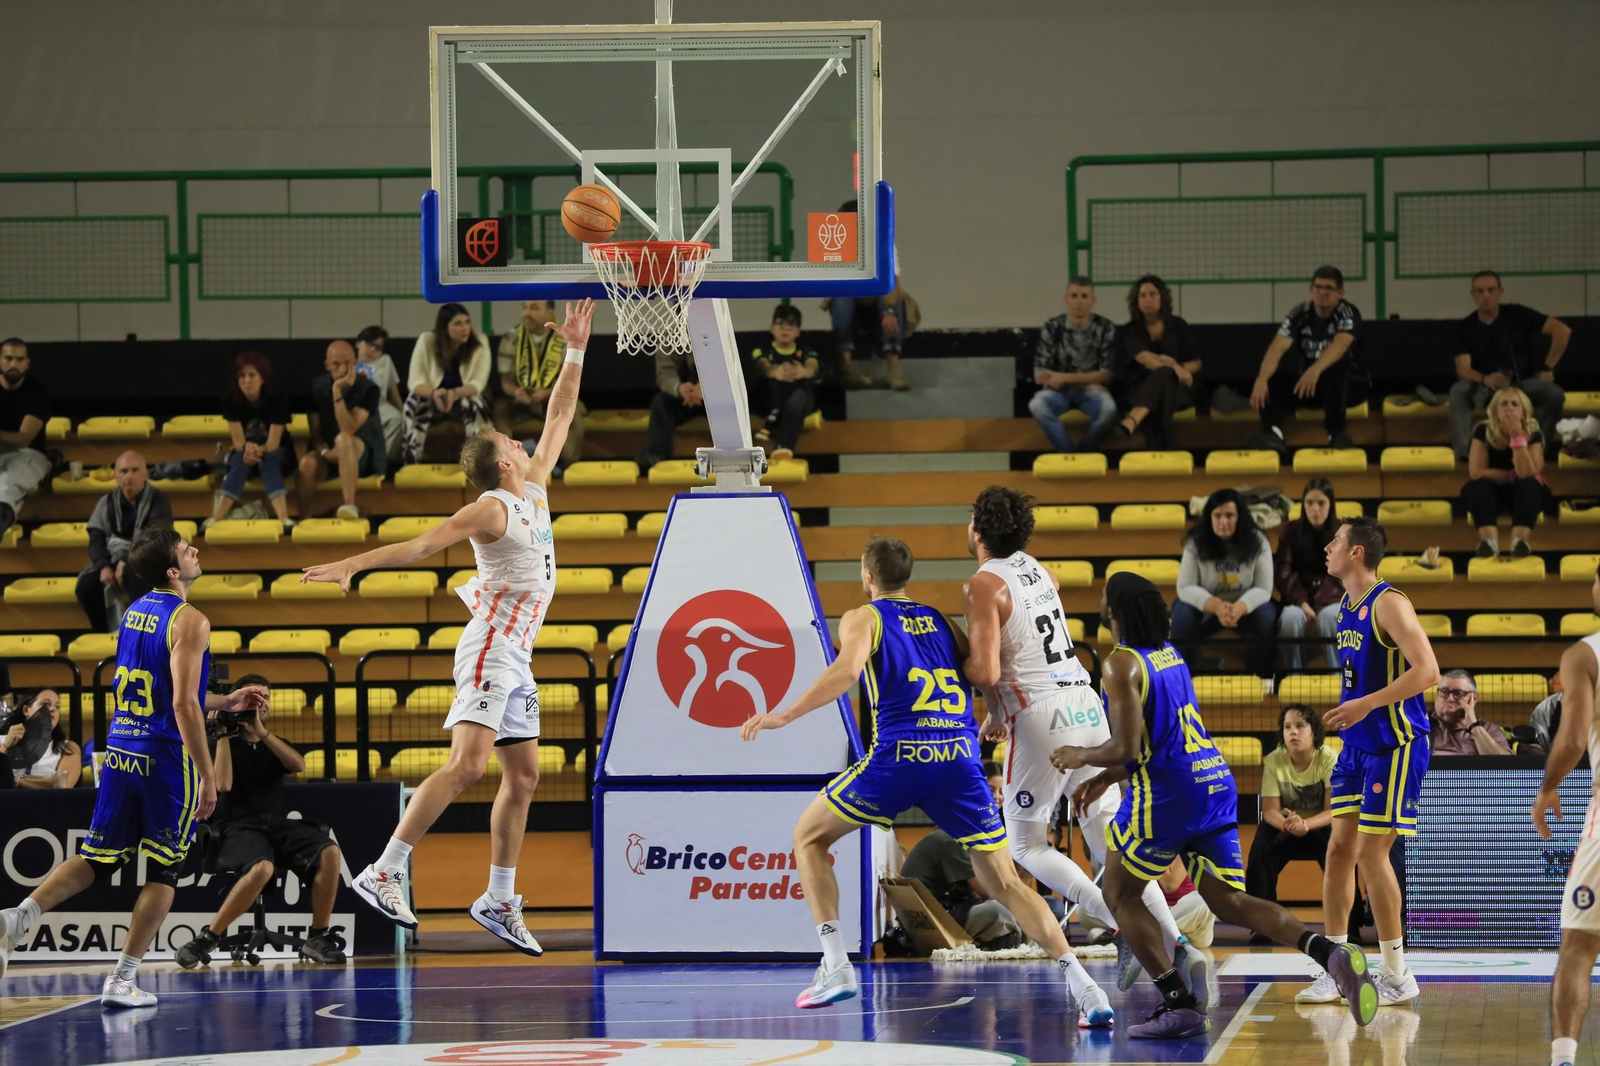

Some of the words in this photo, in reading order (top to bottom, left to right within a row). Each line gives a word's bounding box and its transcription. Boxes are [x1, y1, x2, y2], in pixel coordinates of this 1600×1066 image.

[544, 554, 551, 581] 5
[114, 665, 154, 717] 23
[907, 667, 966, 715] 25
[1177, 702, 1214, 753] 10
[902, 741, 969, 763] ROMA
